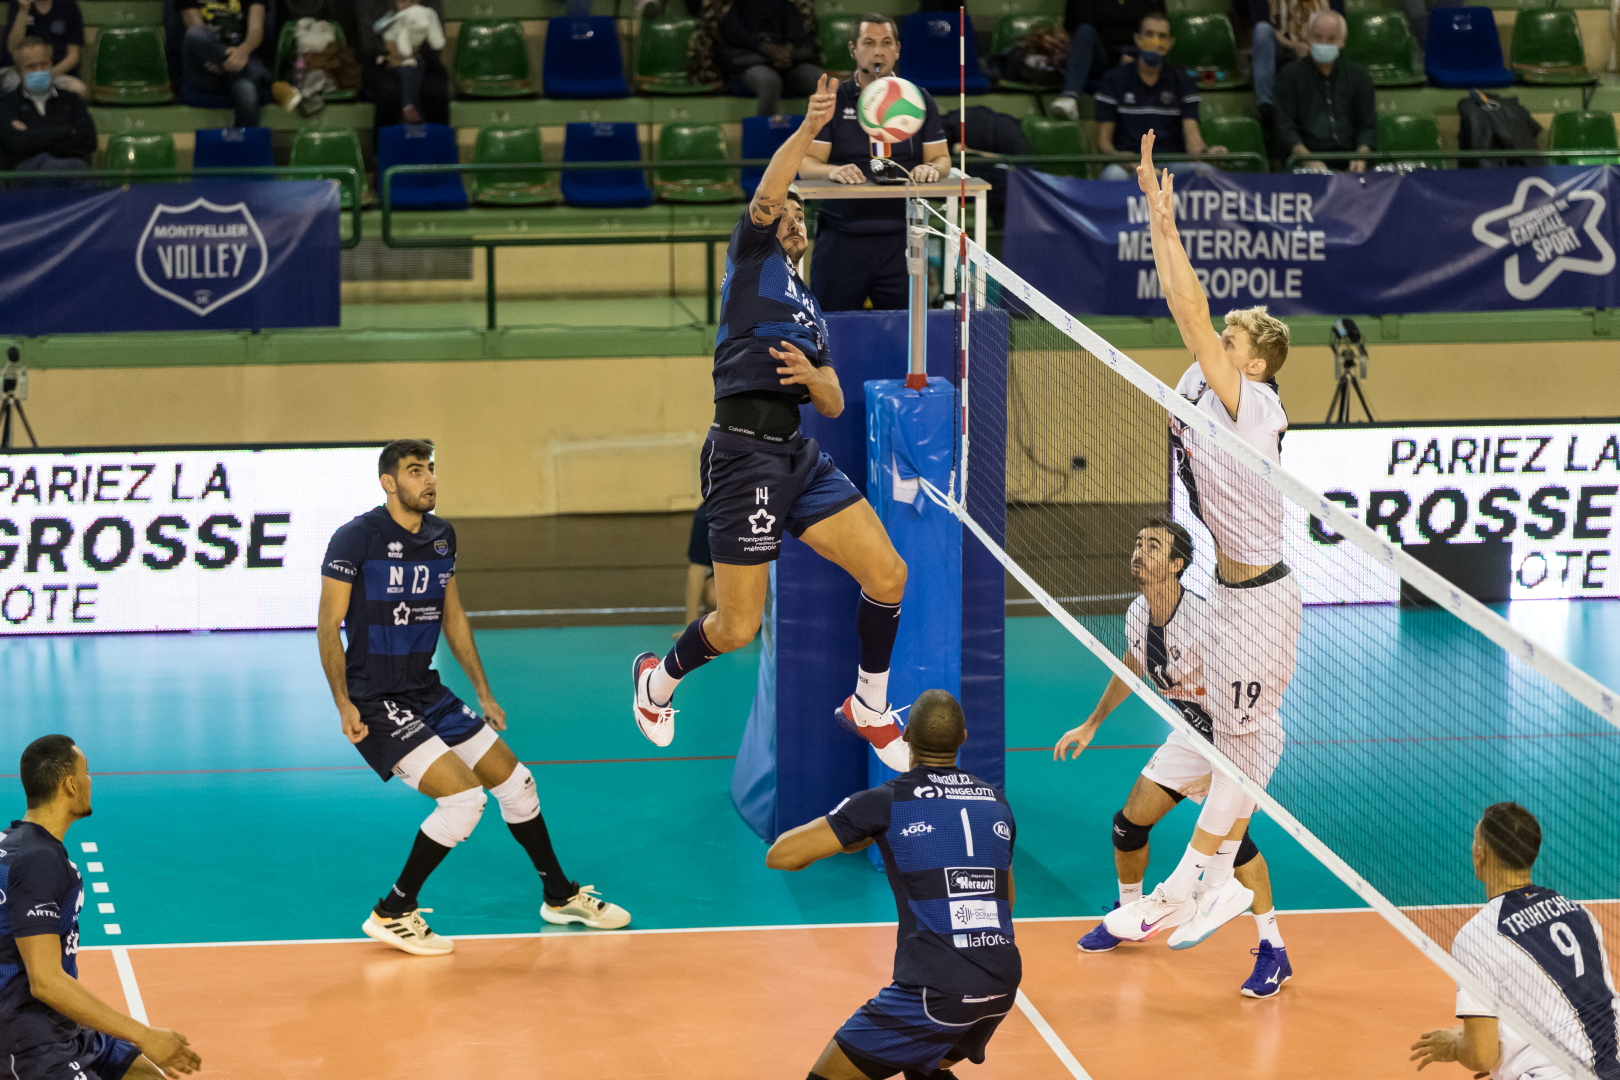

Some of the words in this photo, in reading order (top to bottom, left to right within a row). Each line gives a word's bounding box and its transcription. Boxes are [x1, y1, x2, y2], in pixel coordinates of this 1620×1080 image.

[1127, 189, 1315, 223] MNTPELLIER
[153, 223, 248, 239] MONTPELLIER
[1118, 224, 1326, 261] MÉTERRANÉE
[1532, 225, 1581, 263] SPORT
[157, 243, 247, 279] VOLLEY
[1137, 267, 1303, 299] MROPOLE
[1387, 436, 1553, 476] PARIEZ
[1564, 435, 1620, 473] LA
[171, 462, 231, 503] LA
[755, 486, 769, 505] 14
[389, 565, 404, 585] N
[412, 565, 430, 594] 13
[1231, 680, 1262, 709] 19
[944, 787, 995, 797] ANGELOTTI
[908, 824, 926, 834] GO
[960, 807, 974, 857] 1
[1549, 921, 1584, 978] 9
